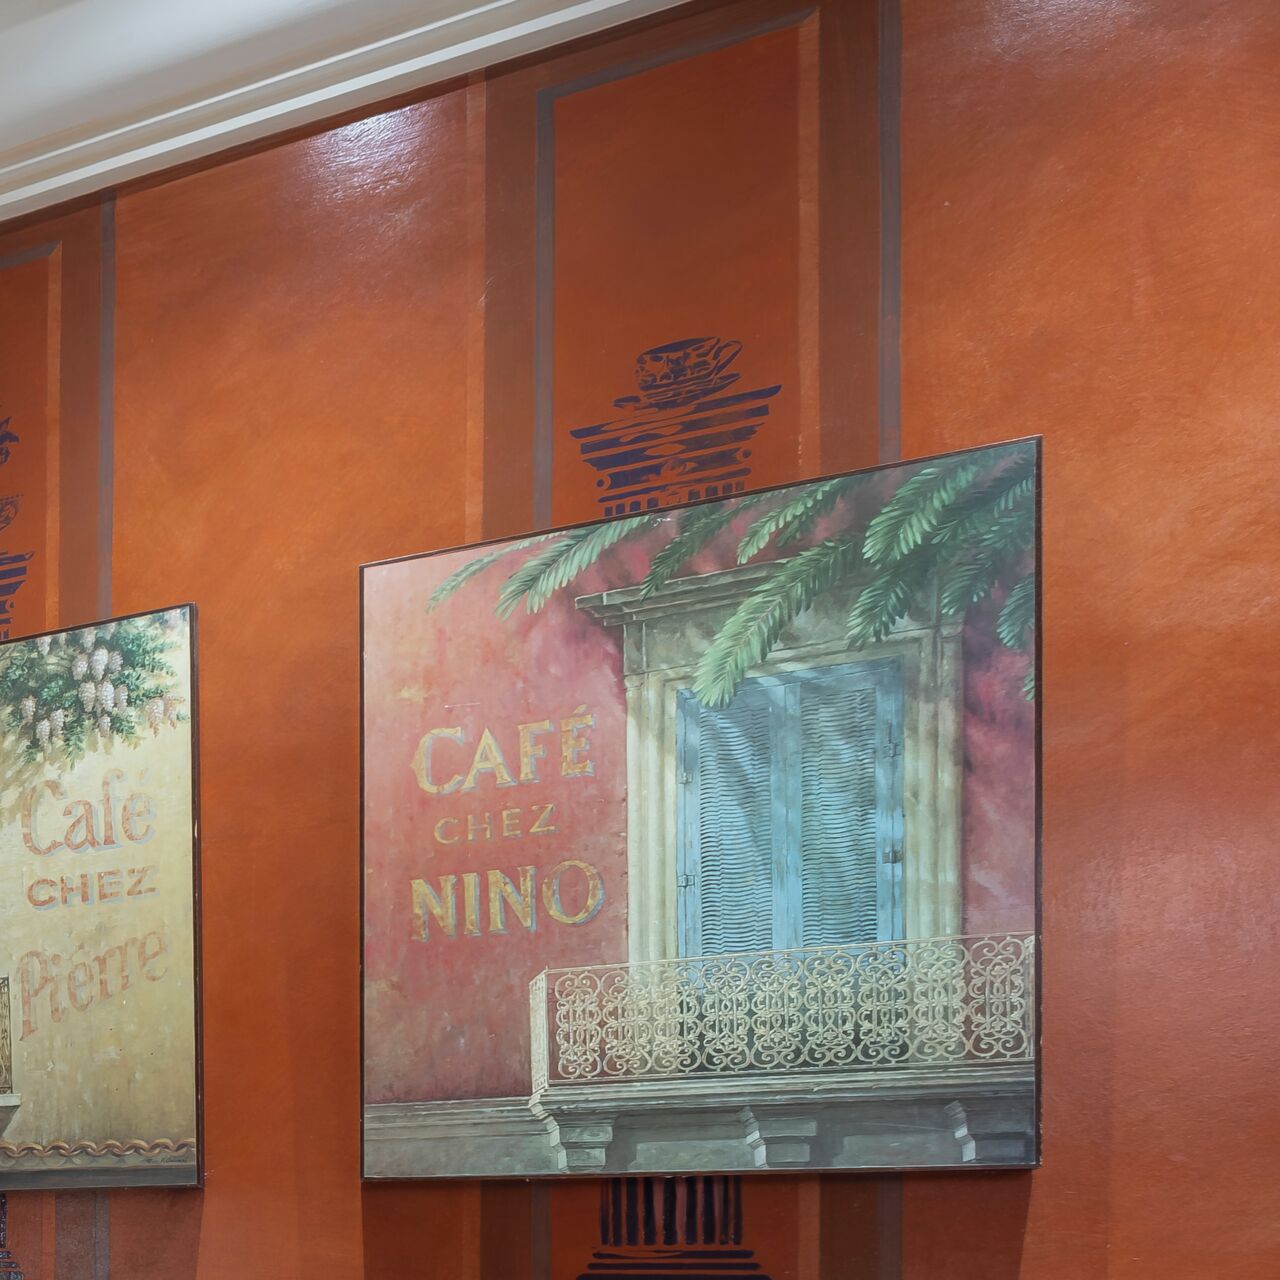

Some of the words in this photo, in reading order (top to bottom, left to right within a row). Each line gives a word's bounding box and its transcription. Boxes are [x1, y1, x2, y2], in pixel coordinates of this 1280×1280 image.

[410, 704, 596, 795] CAFÉ
[21, 767, 156, 858] Café
[433, 803, 558, 844] CHEZ
[27, 864, 158, 912] CHEZ
[410, 859, 606, 943] NINO
[18, 930, 169, 1042] Pierre
